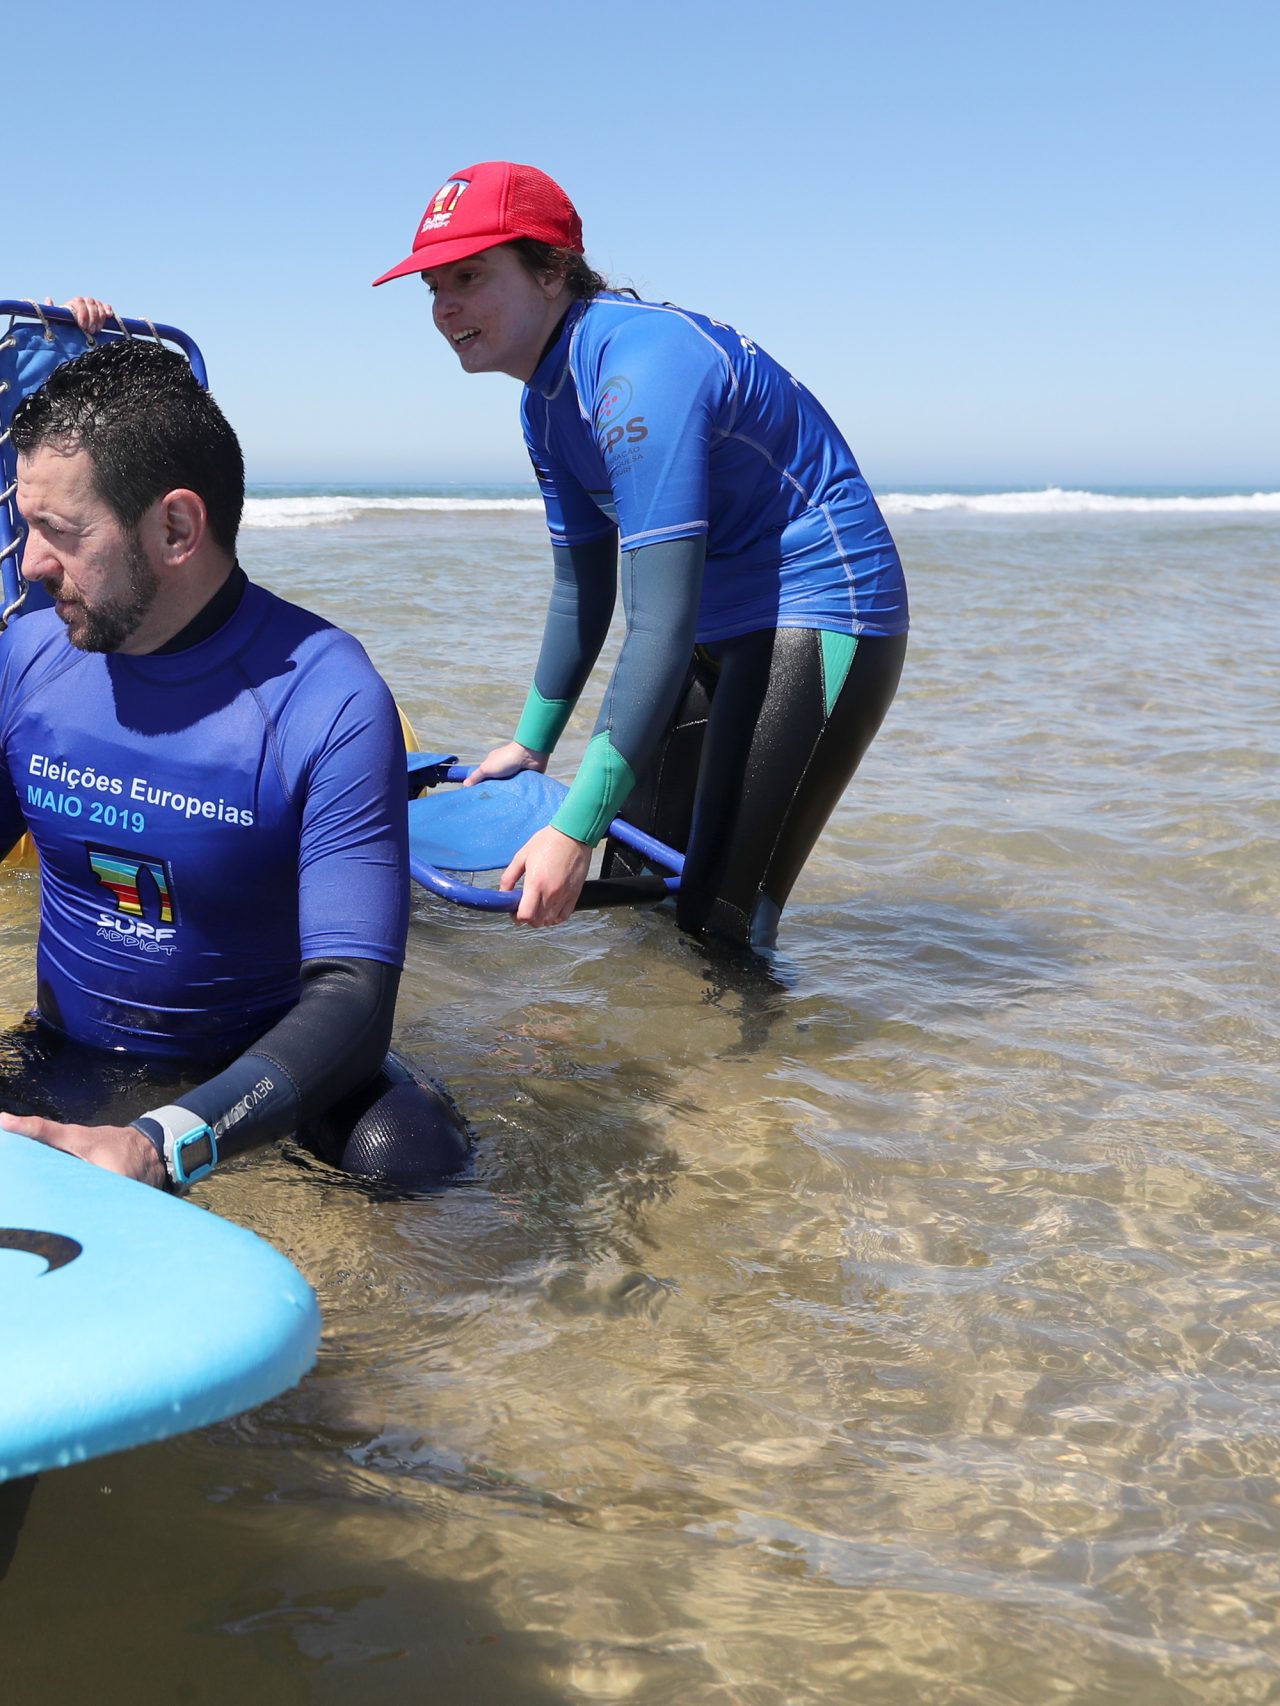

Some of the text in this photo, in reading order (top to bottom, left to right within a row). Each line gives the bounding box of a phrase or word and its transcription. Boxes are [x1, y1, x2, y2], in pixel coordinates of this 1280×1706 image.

[27, 785, 145, 833] MAIO 2019
[28, 754, 254, 826] Eleições Europeias
[96, 913, 176, 943] SURF
[96, 927, 177, 956] ADDICT
